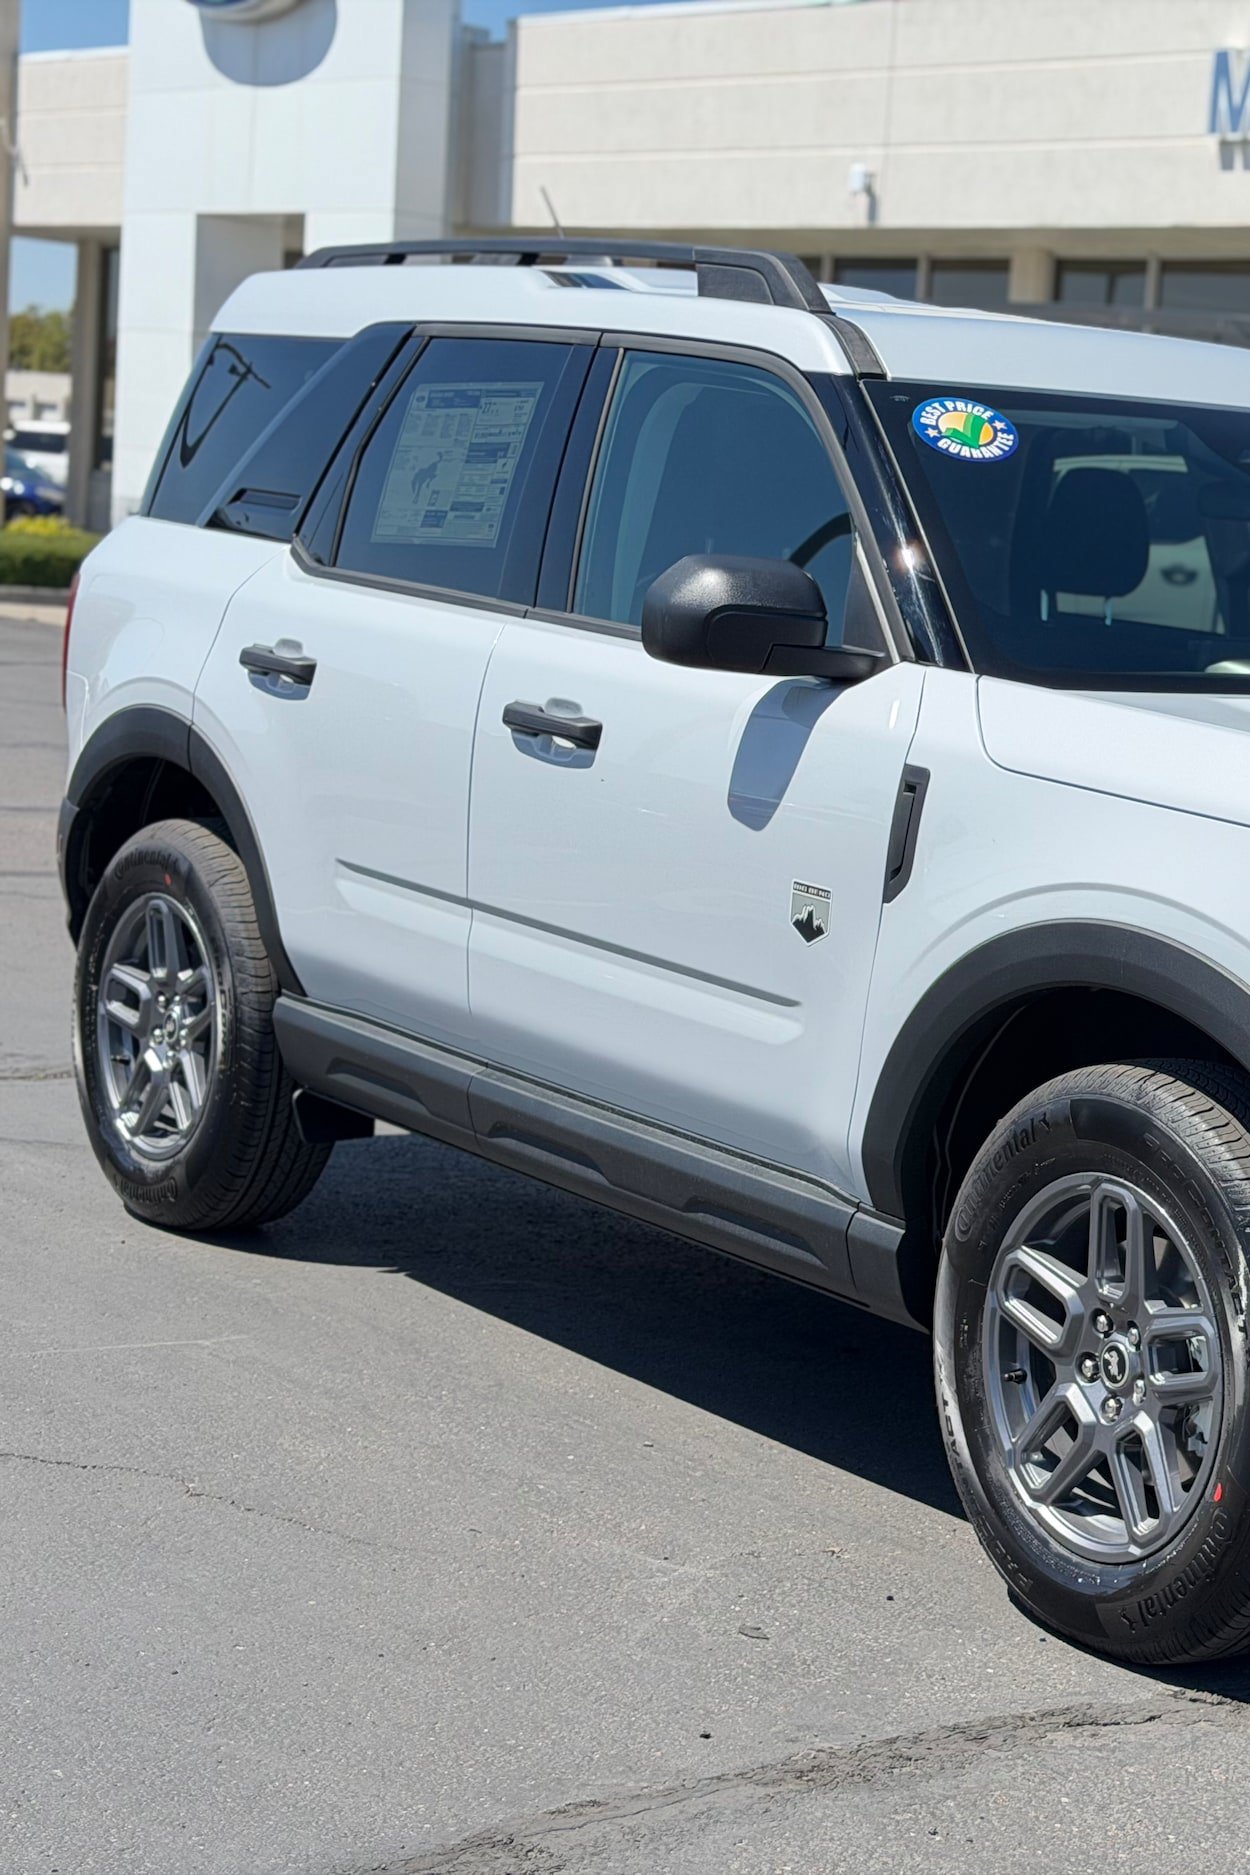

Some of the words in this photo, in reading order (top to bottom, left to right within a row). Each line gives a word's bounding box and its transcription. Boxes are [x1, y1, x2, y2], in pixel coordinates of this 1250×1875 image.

[919, 402, 946, 426] BEST
[944, 400, 995, 420] PRICE
[937, 431, 1015, 459] GUARANTEE
[954, 1118, 1039, 1243] Continental
[1137, 1506, 1233, 1628] Continental
